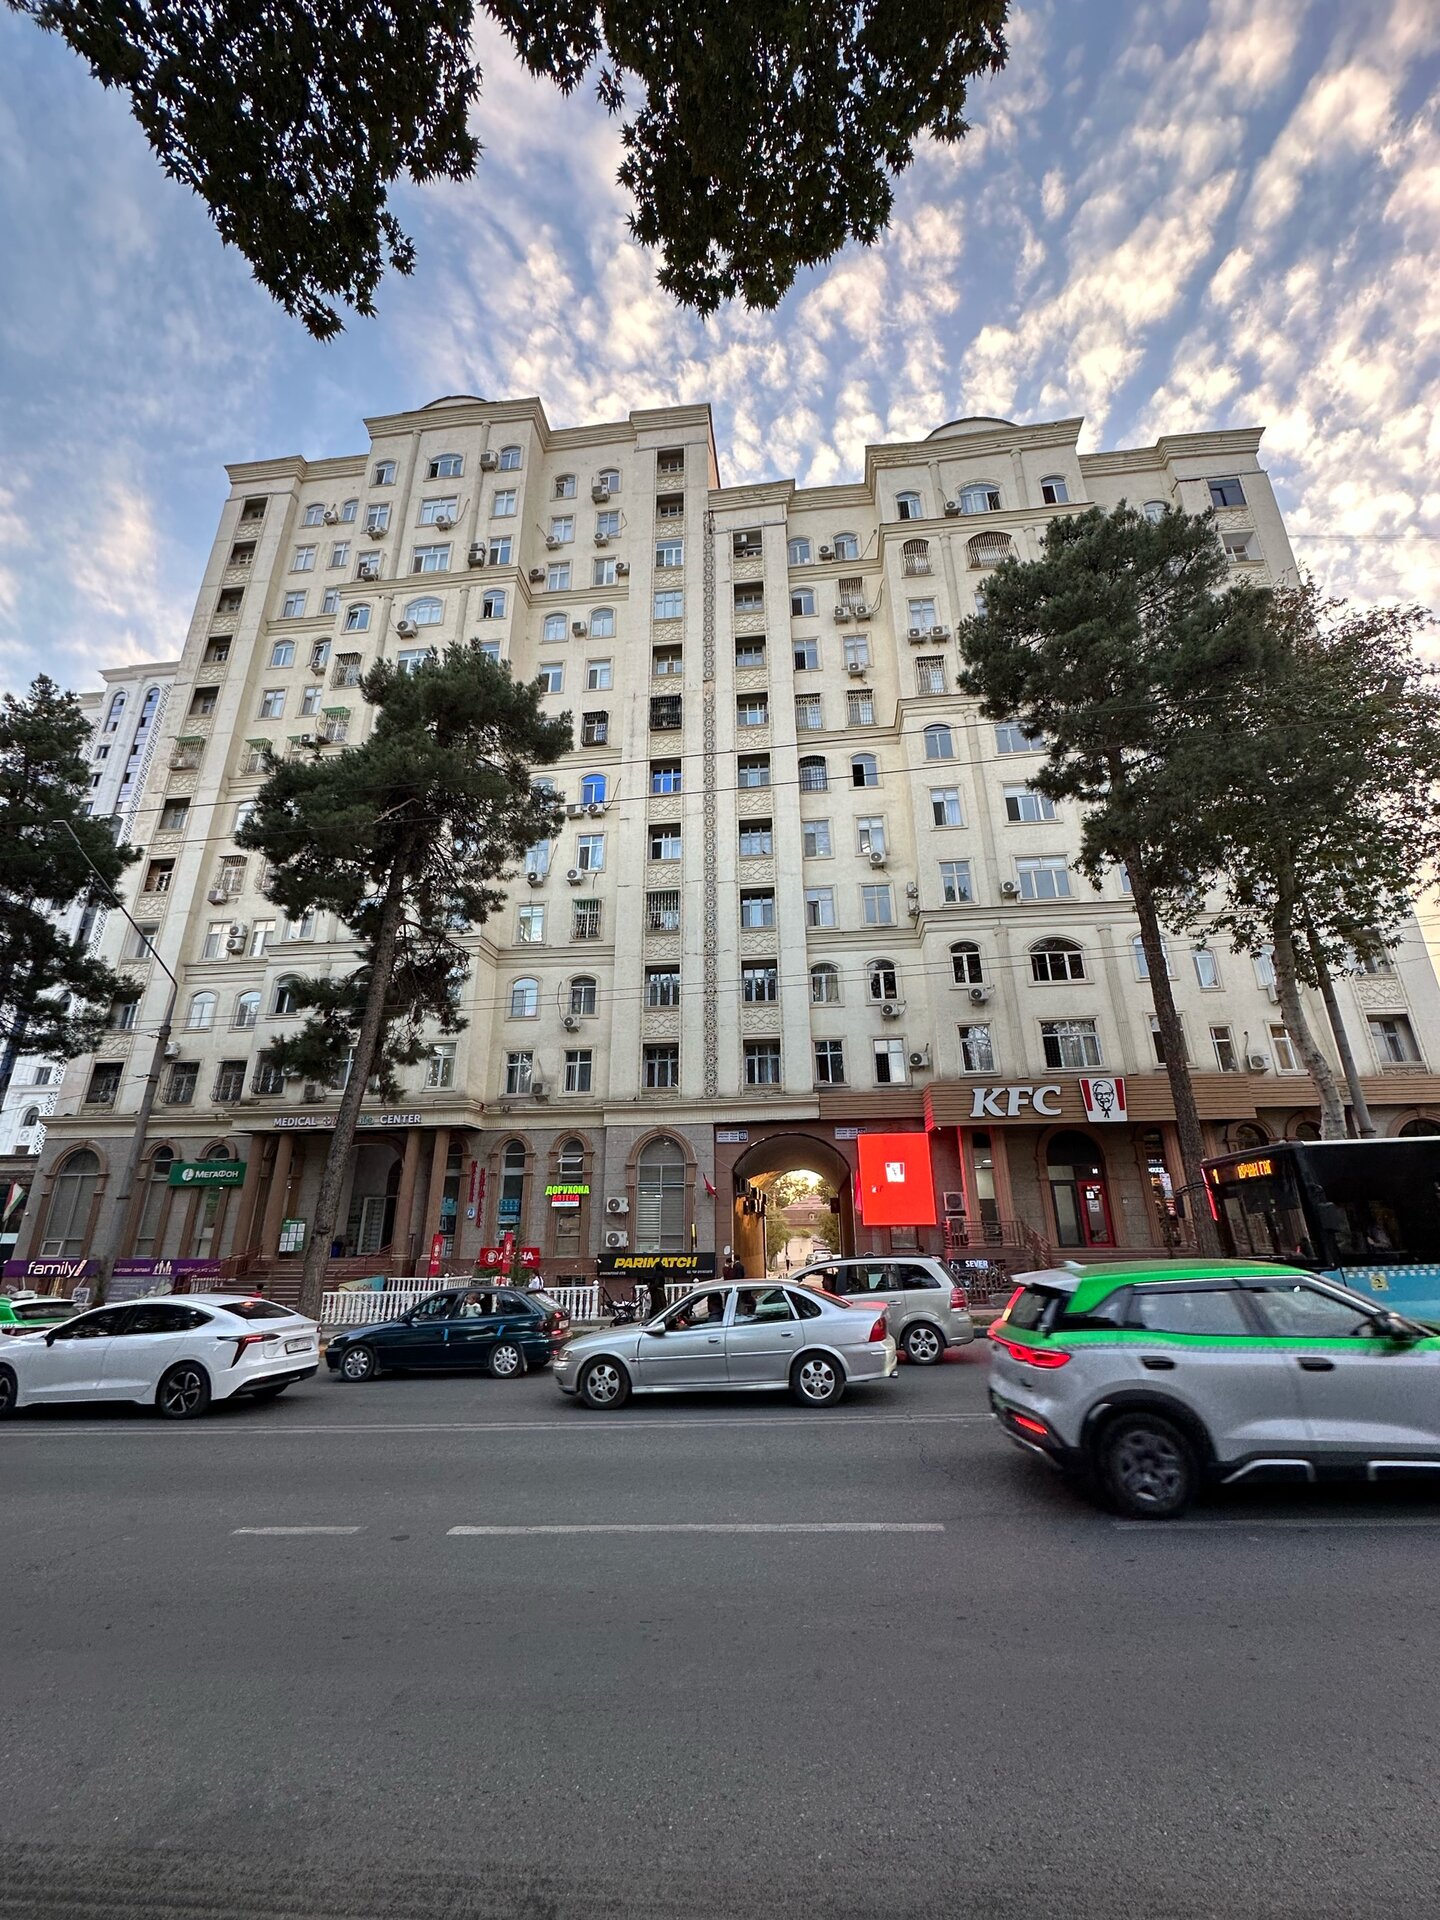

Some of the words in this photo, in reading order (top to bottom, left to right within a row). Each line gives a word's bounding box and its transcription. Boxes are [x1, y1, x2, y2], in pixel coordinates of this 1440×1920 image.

[969, 1085, 1062, 1118] KFC
[273, 1116, 317, 1127] MEDICAL
[380, 1114, 421, 1125] CENTER
[545, 1185, 590, 1196] ДОРУХОНА
[27, 1261, 77, 1278] family
[965, 1260, 989, 1269] SEVER
